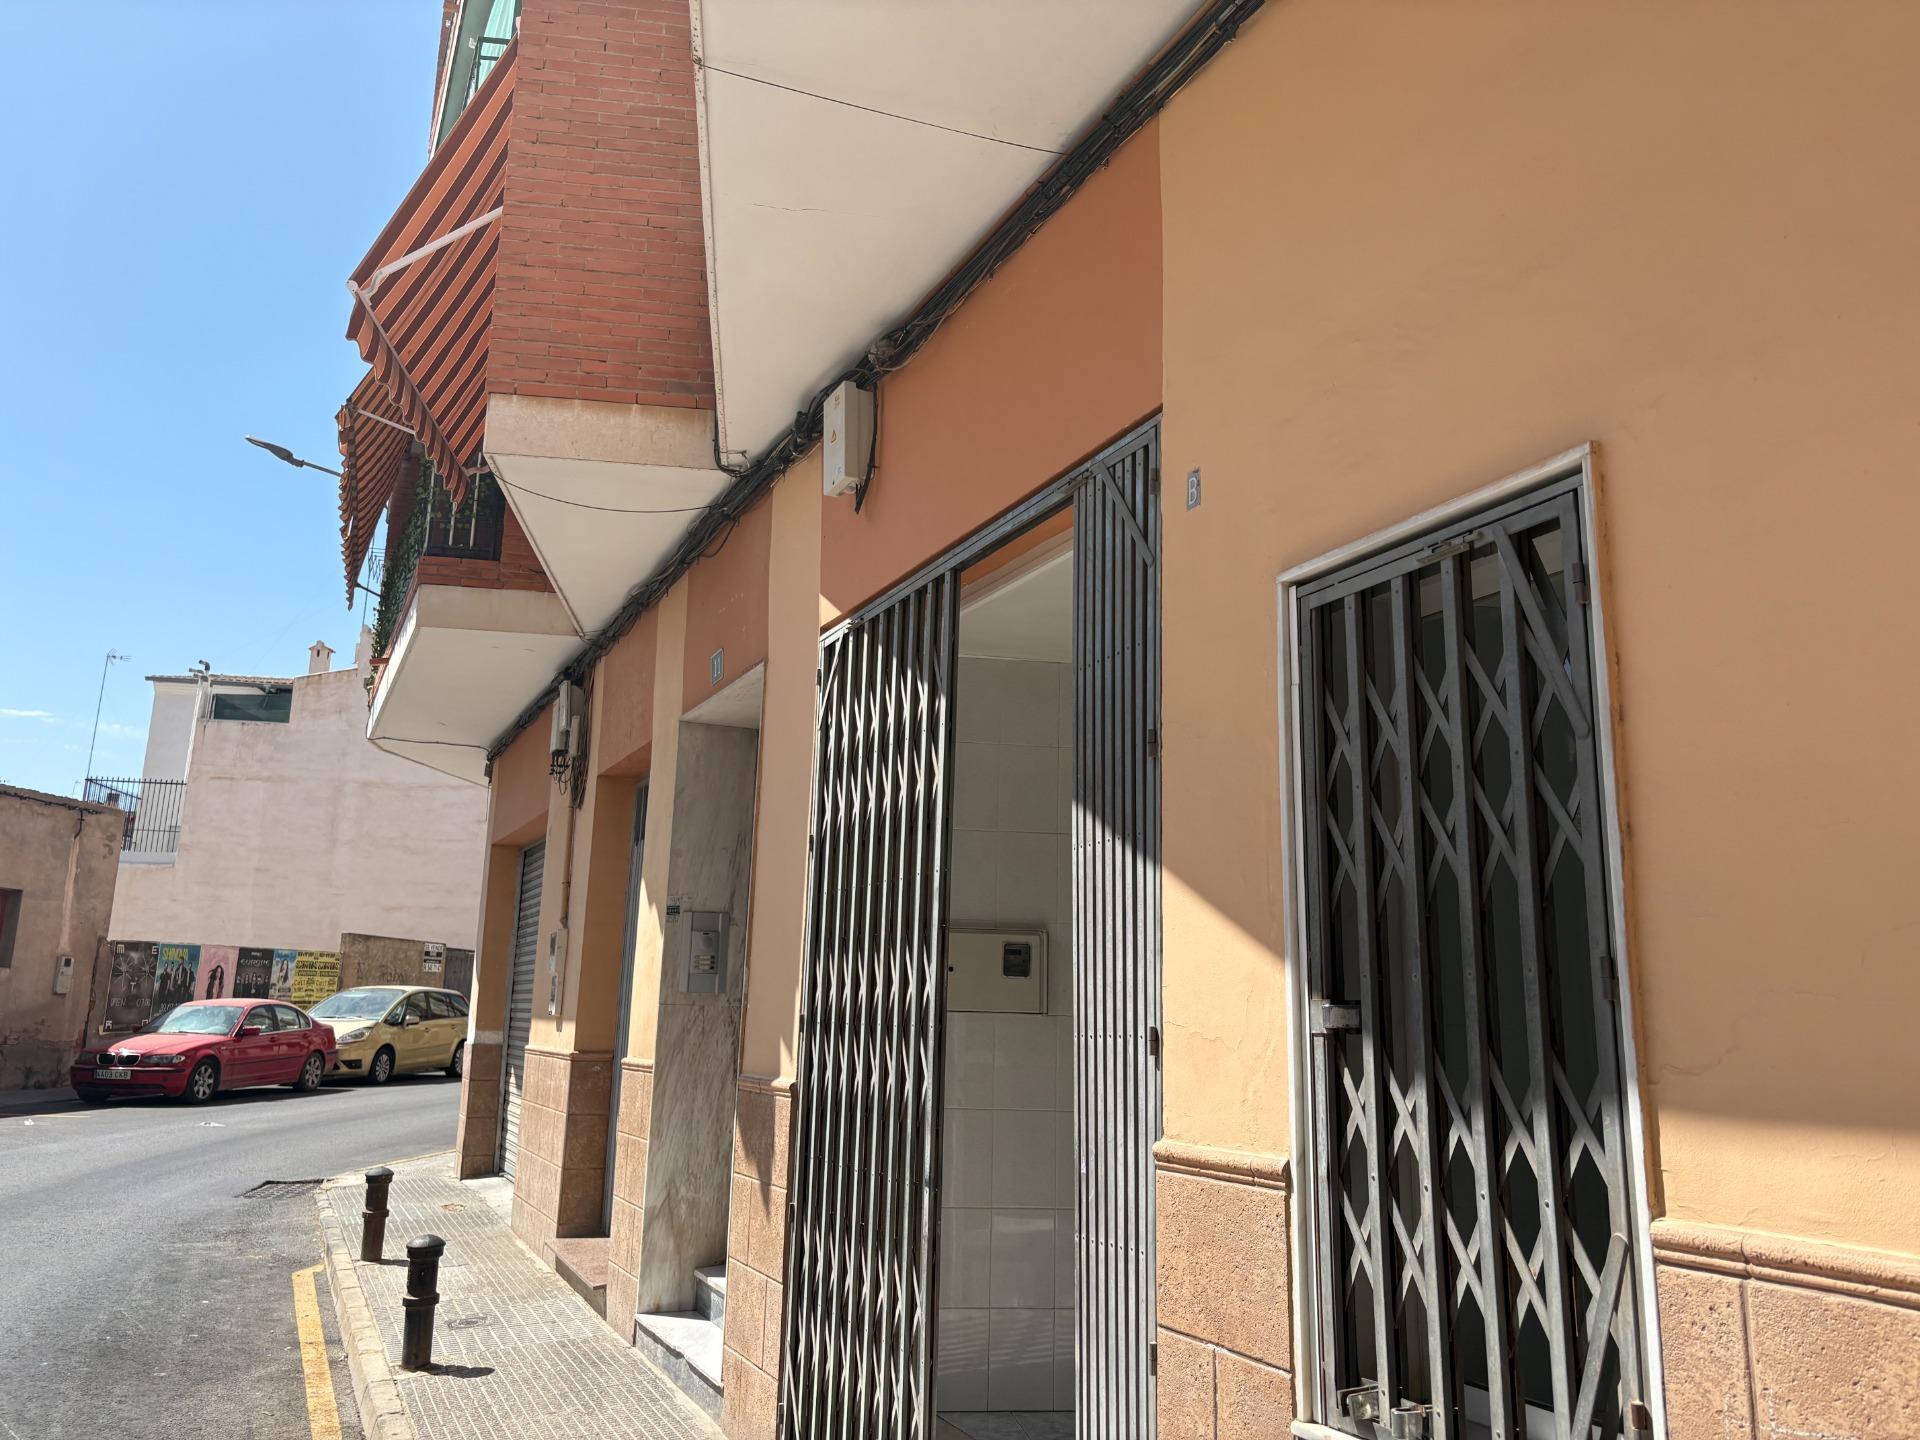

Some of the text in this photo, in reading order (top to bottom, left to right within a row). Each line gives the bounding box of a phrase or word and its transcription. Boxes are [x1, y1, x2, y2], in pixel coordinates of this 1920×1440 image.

[1188, 477, 1197, 505] B
[152, 946, 159, 955] E
[240, 958, 270, 967] EUROPE
[130, 982, 137, 992] T
